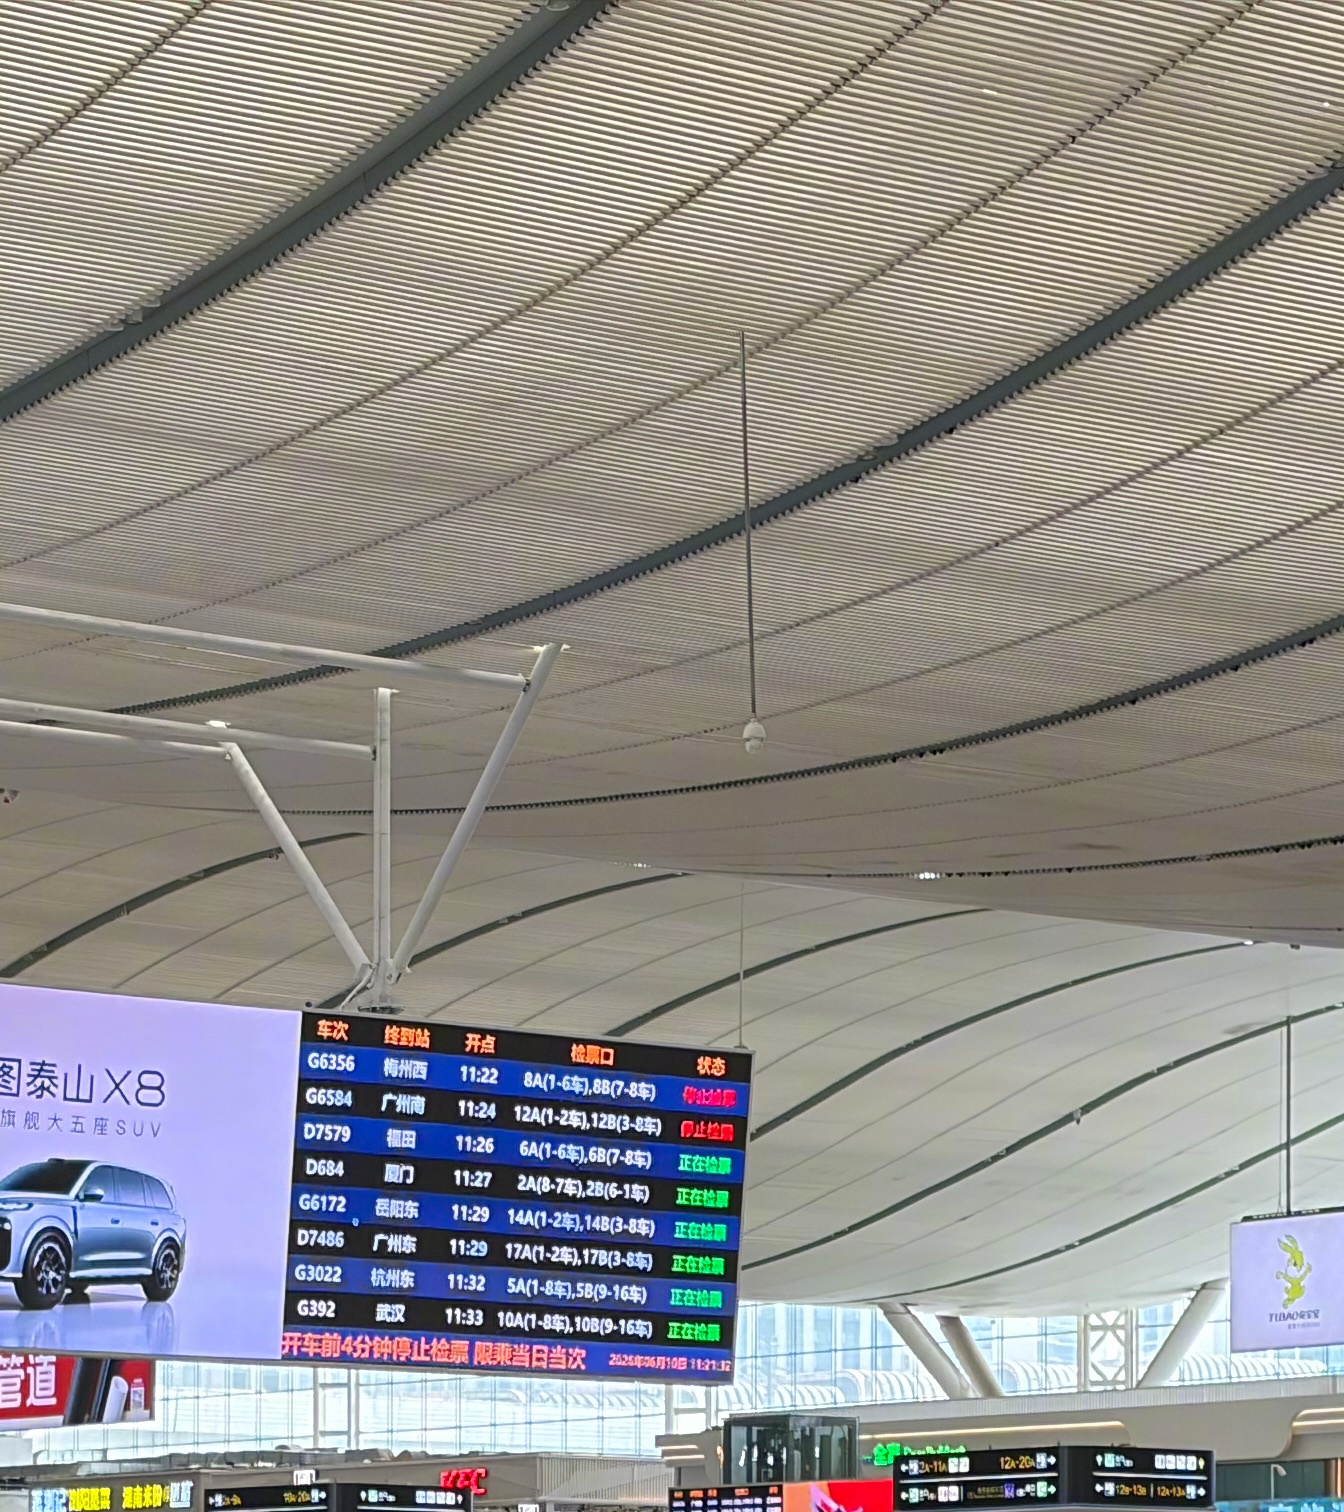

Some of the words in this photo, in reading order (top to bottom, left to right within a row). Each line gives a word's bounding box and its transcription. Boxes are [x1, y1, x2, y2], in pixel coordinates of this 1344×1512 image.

[316, 1019, 349, 1042] 车次
[383, 1024, 431, 1049] 终到站
[464, 1032, 497, 1055] 开点
[570, 1042, 615, 1066] 检票口
[696, 1056, 726, 1077] 状态
[305, 1087, 353, 1108] G6584
[380, 1093, 426, 1116] 广州南
[458, 1100, 497, 1120] 11:24
[680, 1120, 735, 1142] 停止检票
[303, 1122, 352, 1143] D7579
[386, 1128, 417, 1150] 福田
[456, 1134, 495, 1154] 11:26
[677, 1153, 732, 1175] 正在检票
[297, 1229, 344, 1248] D7486
[372, 1233, 417, 1254] 广州东
[449, 1238, 488, 1257] 11:29
[671, 1254, 725, 1275] 正在检票
[297, 1299, 336, 1318] G392
[375, 1303, 406, 1323] 武汉
[445, 1308, 484, 1326] 11:33
[667, 1321, 720, 1341] 正在检票
[281, 1331, 469, 1364] 开车前4分钟停止检票
